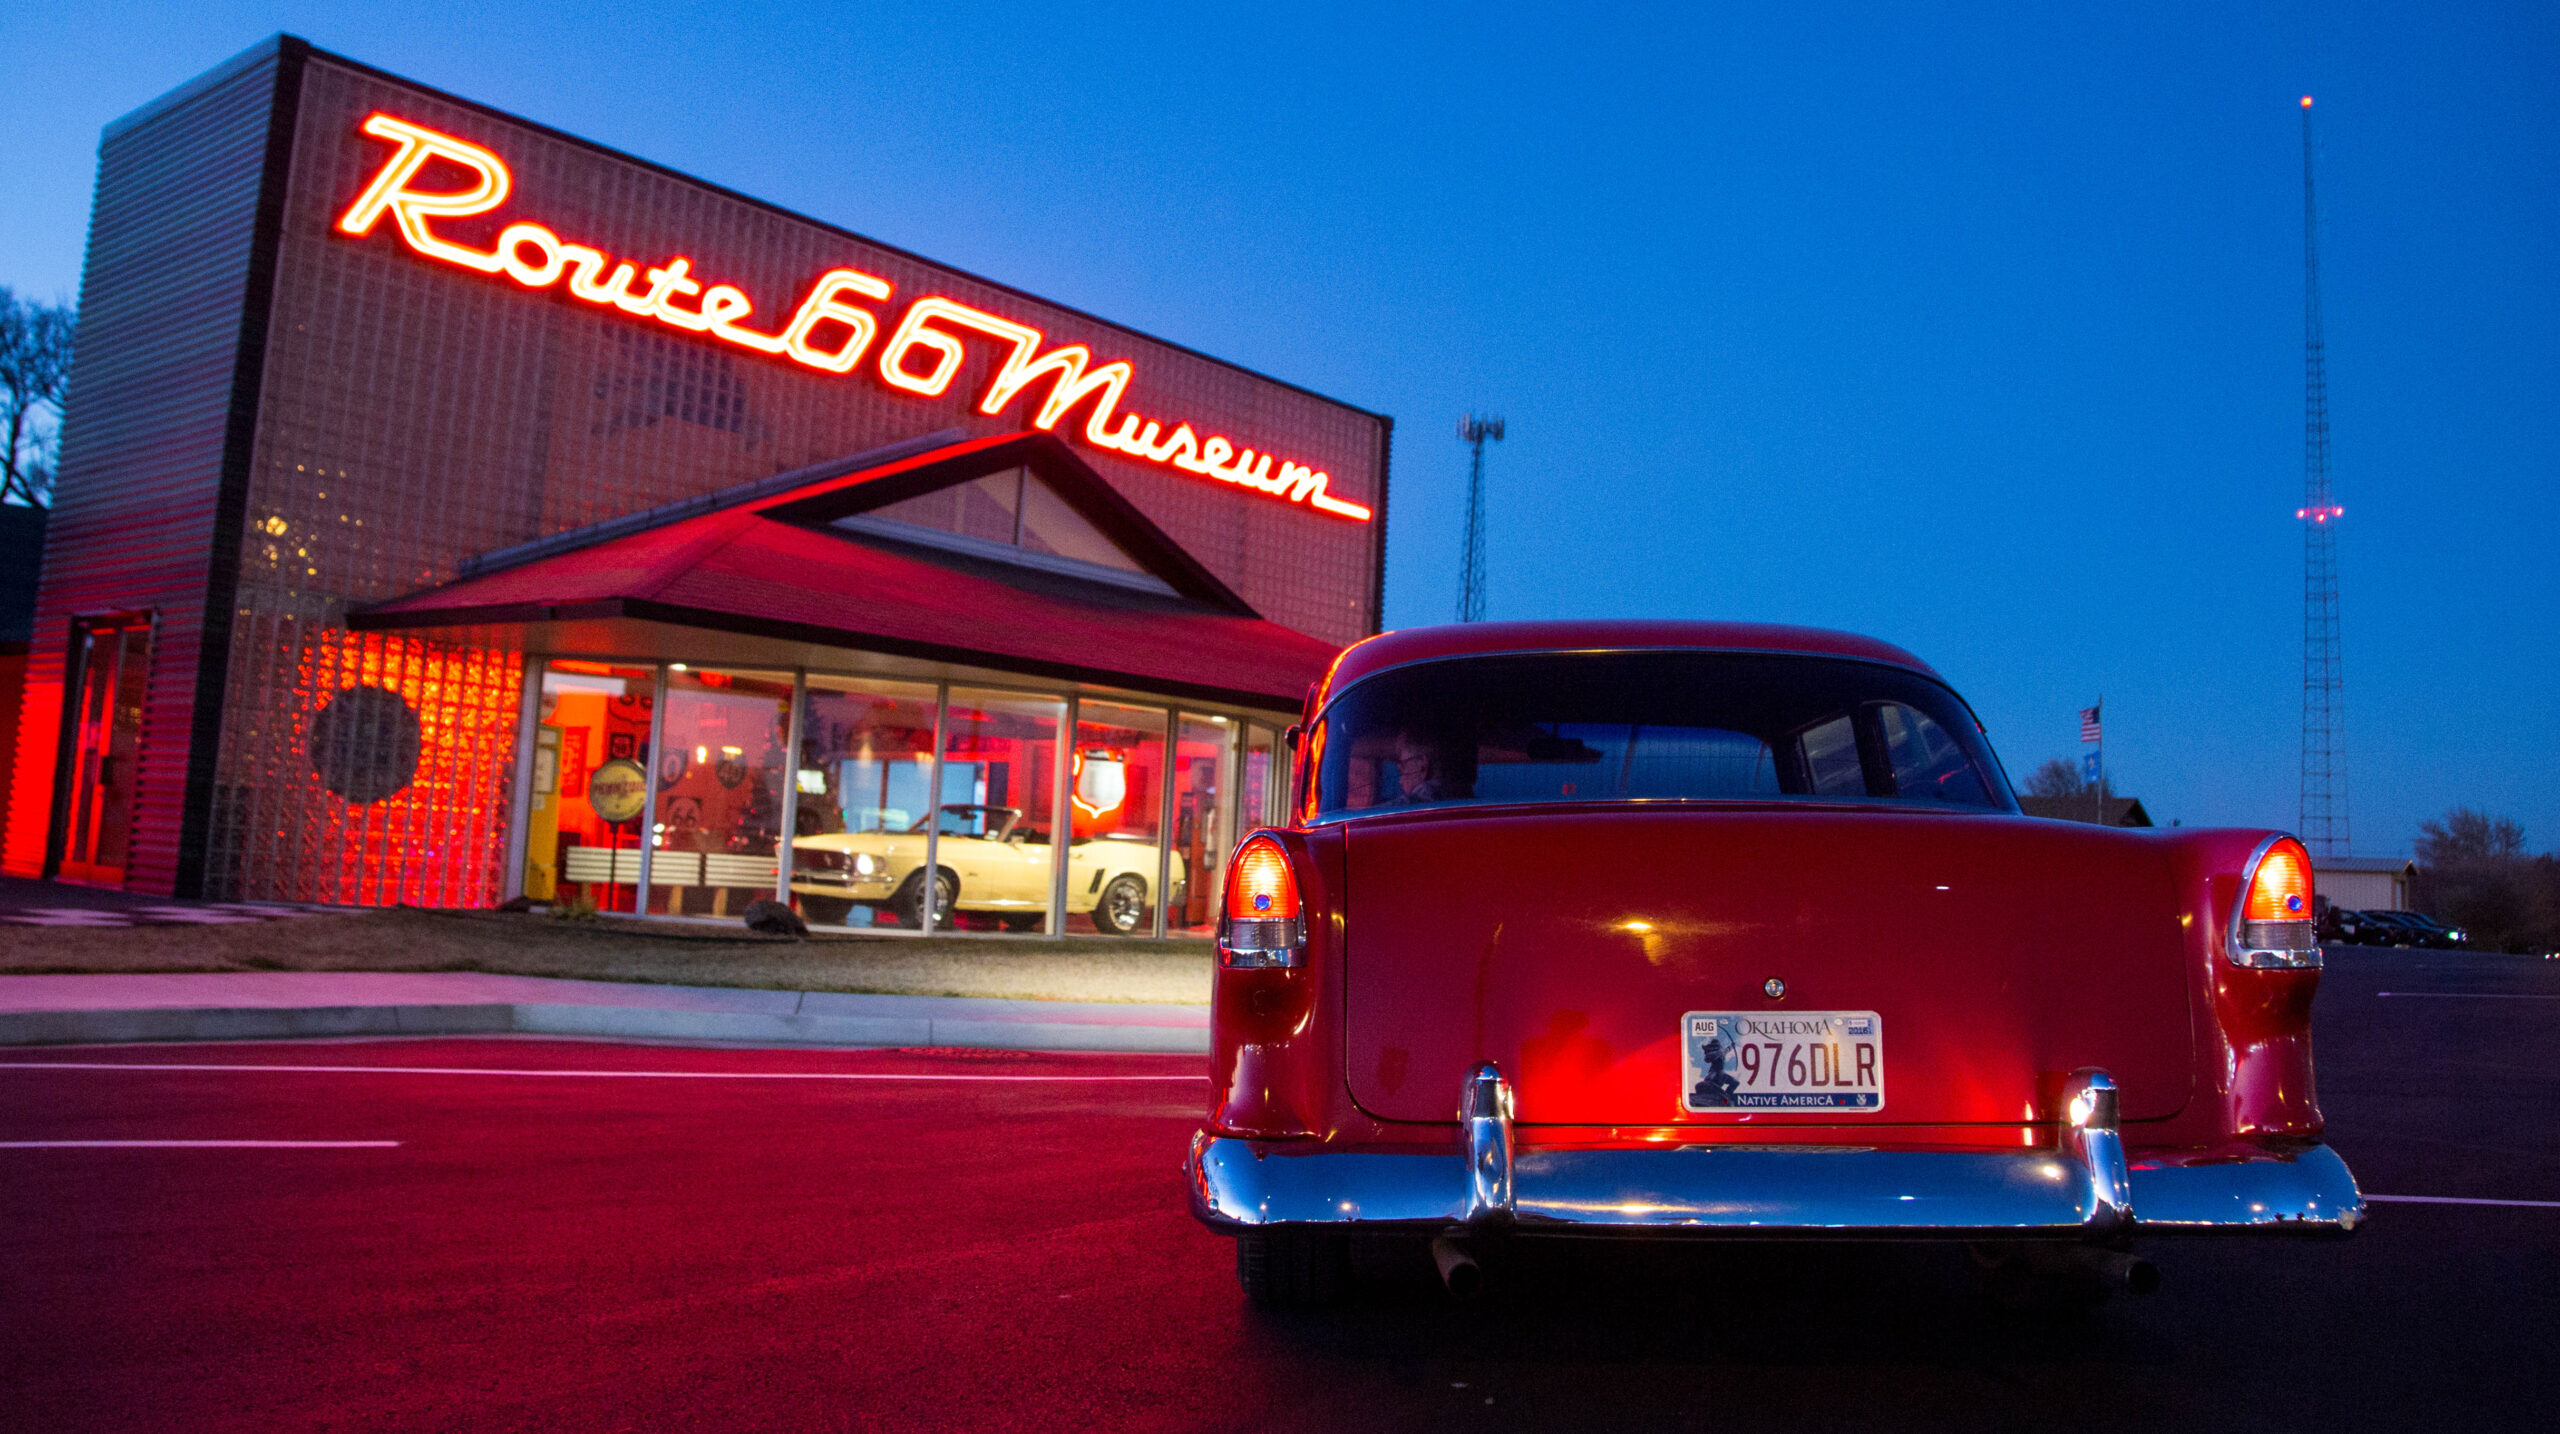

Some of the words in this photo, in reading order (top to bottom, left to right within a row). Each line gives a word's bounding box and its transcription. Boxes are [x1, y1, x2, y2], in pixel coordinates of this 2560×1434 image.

[337, 112, 786, 354] Route
[784, 267, 966, 397] 66
[980, 318, 1372, 520] Museum
[1695, 1021, 1714, 1032] AUG
[1734, 1019, 1832, 1041] OKLAHOMA
[1741, 1043, 1876, 1087] 976DLR
[1737, 1095, 1778, 1106] NATIVE
[1780, 1095, 1834, 1106] AMERICA
